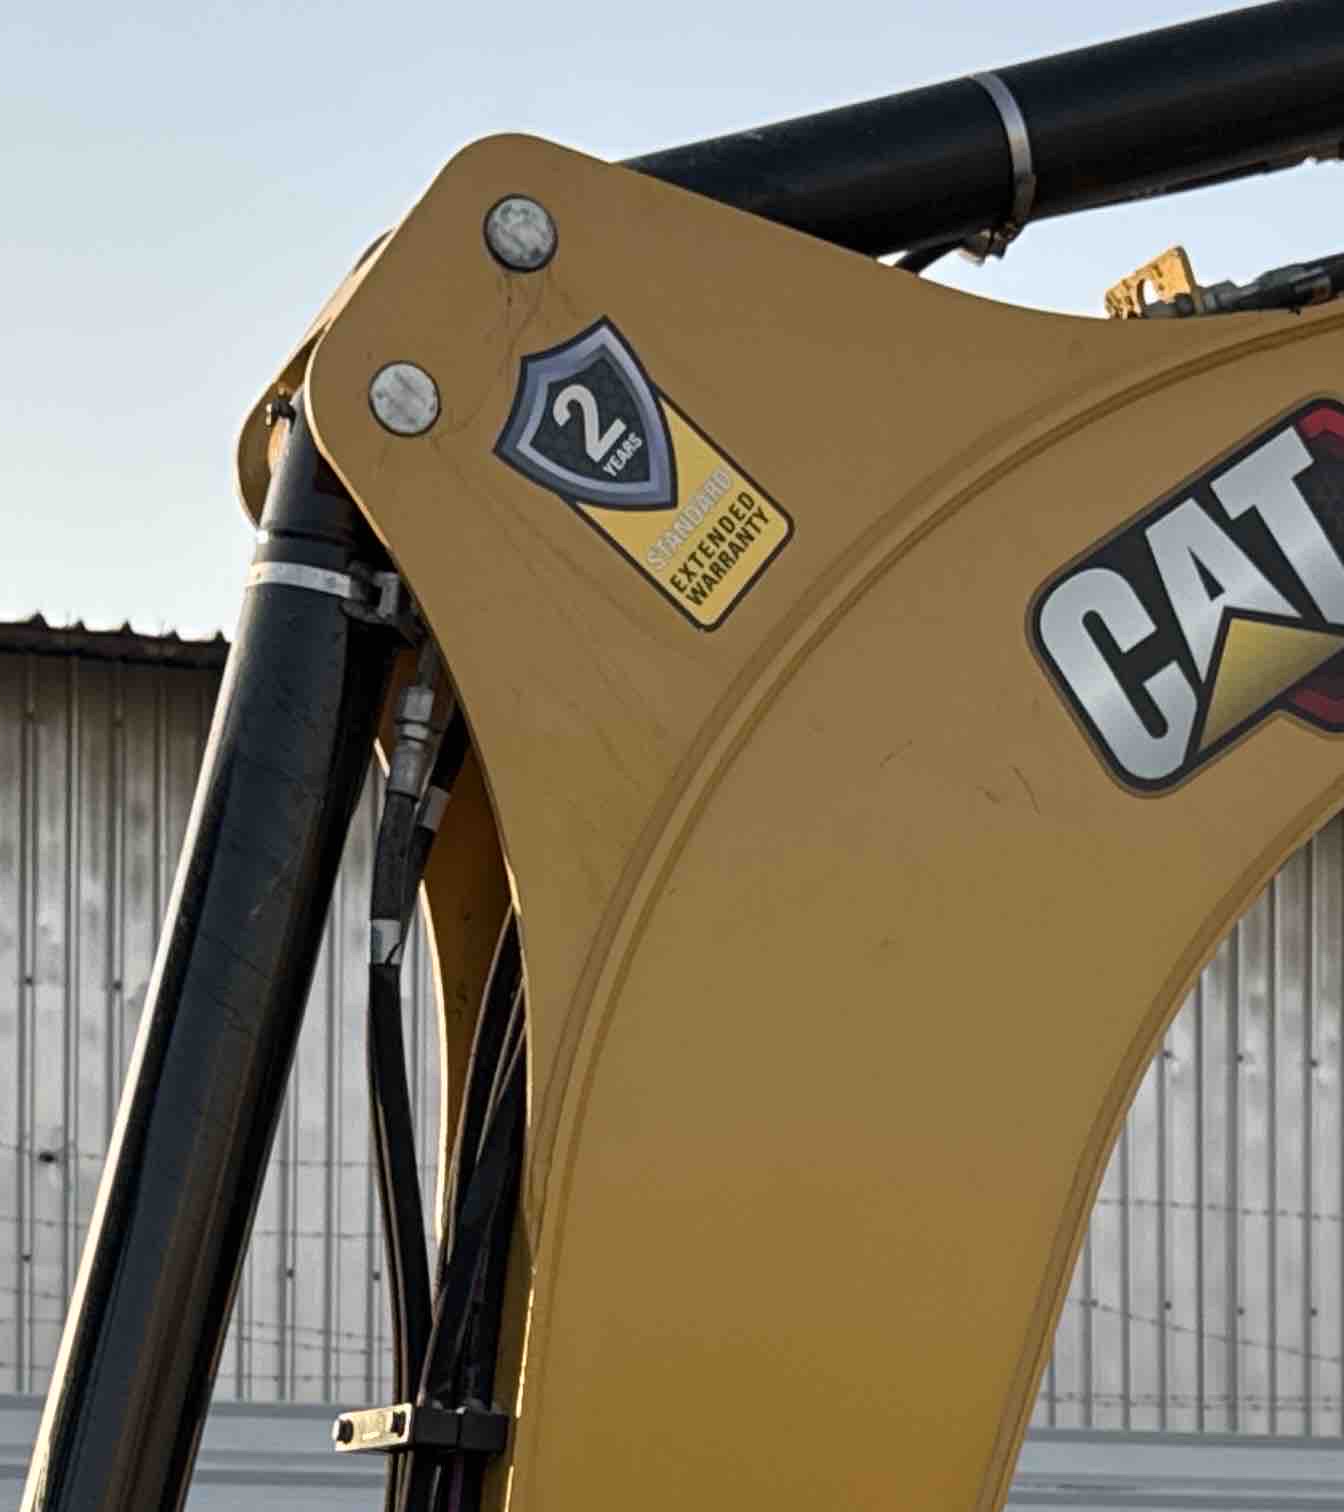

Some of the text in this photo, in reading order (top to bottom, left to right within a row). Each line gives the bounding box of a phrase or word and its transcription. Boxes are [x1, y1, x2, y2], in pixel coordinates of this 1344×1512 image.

[552, 384, 627, 463] 2
[602, 432, 643, 477] YEARS
[669, 491, 755, 593] EXTENDED
[685, 506, 769, 606] WARRANTY
